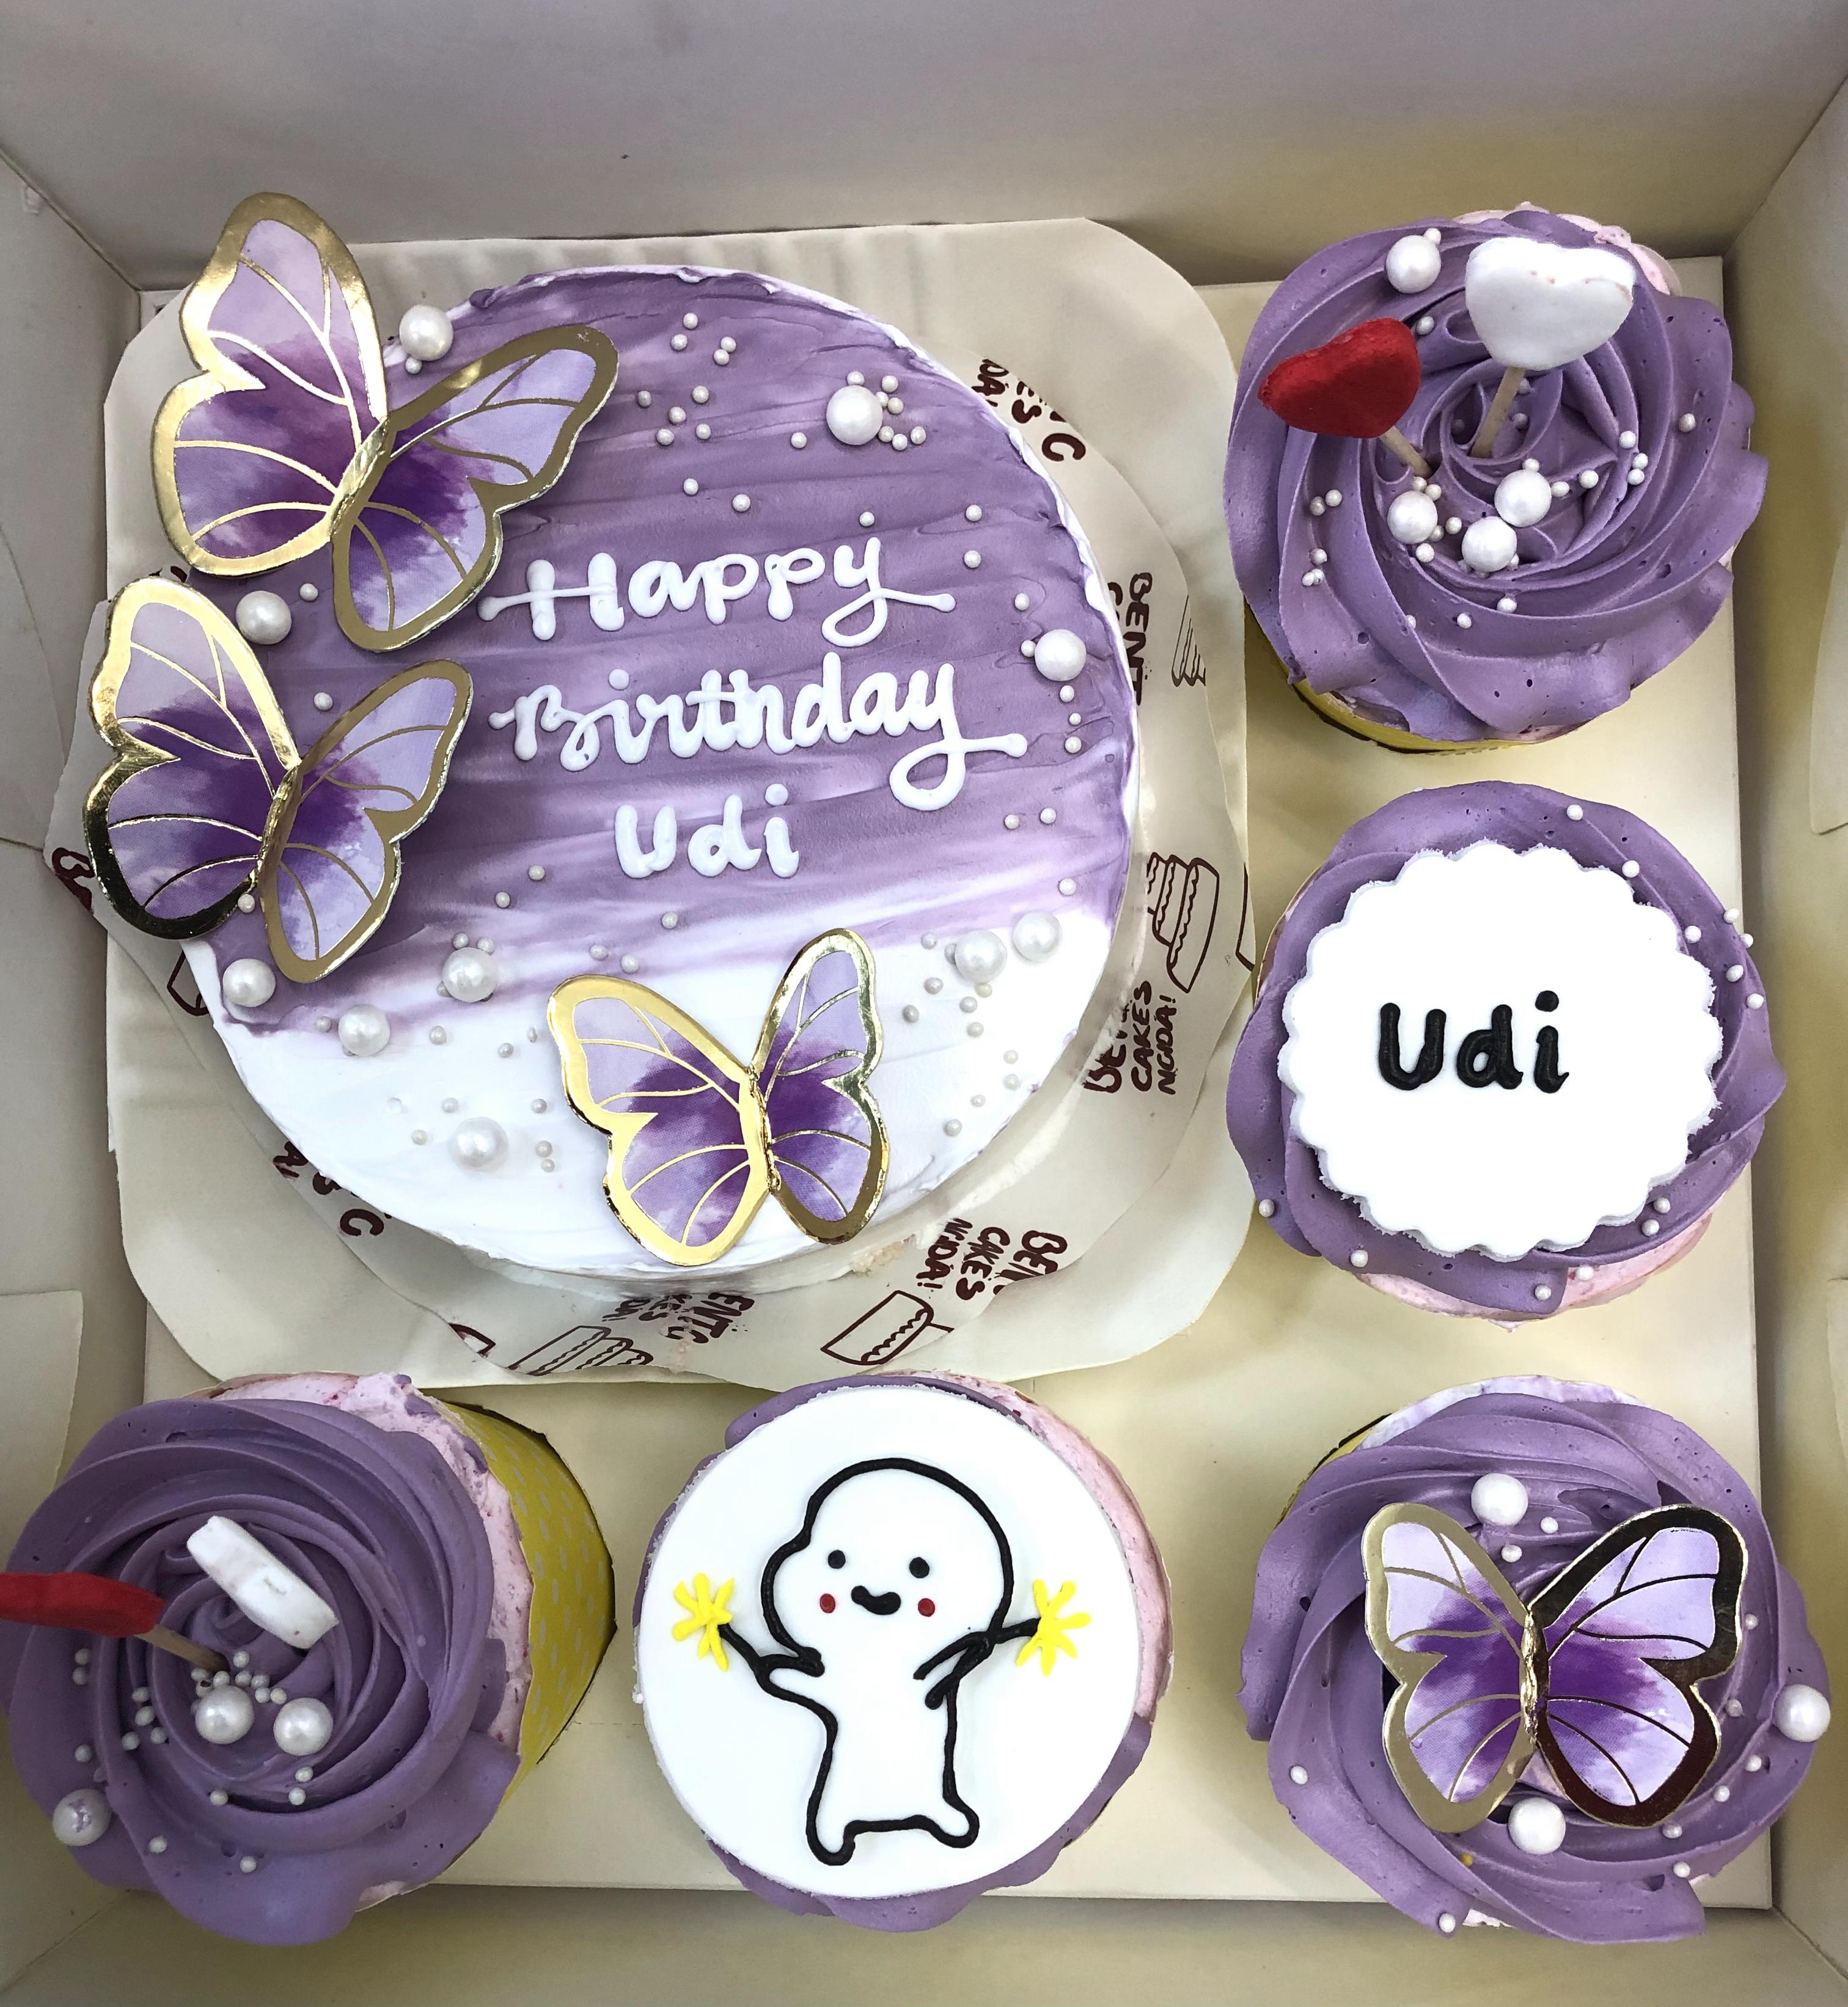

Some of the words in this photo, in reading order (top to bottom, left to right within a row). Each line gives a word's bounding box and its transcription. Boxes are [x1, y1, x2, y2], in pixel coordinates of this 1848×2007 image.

[479, 537, 956, 648] Happy
[1123, 573, 1153, 706] BENT
[489, 652, 1027, 812] Birthday
[615, 783, 799, 878] Udi
[1131, 981, 1154, 1092] CAKES
[1378, 990, 1569, 1094] Udi
